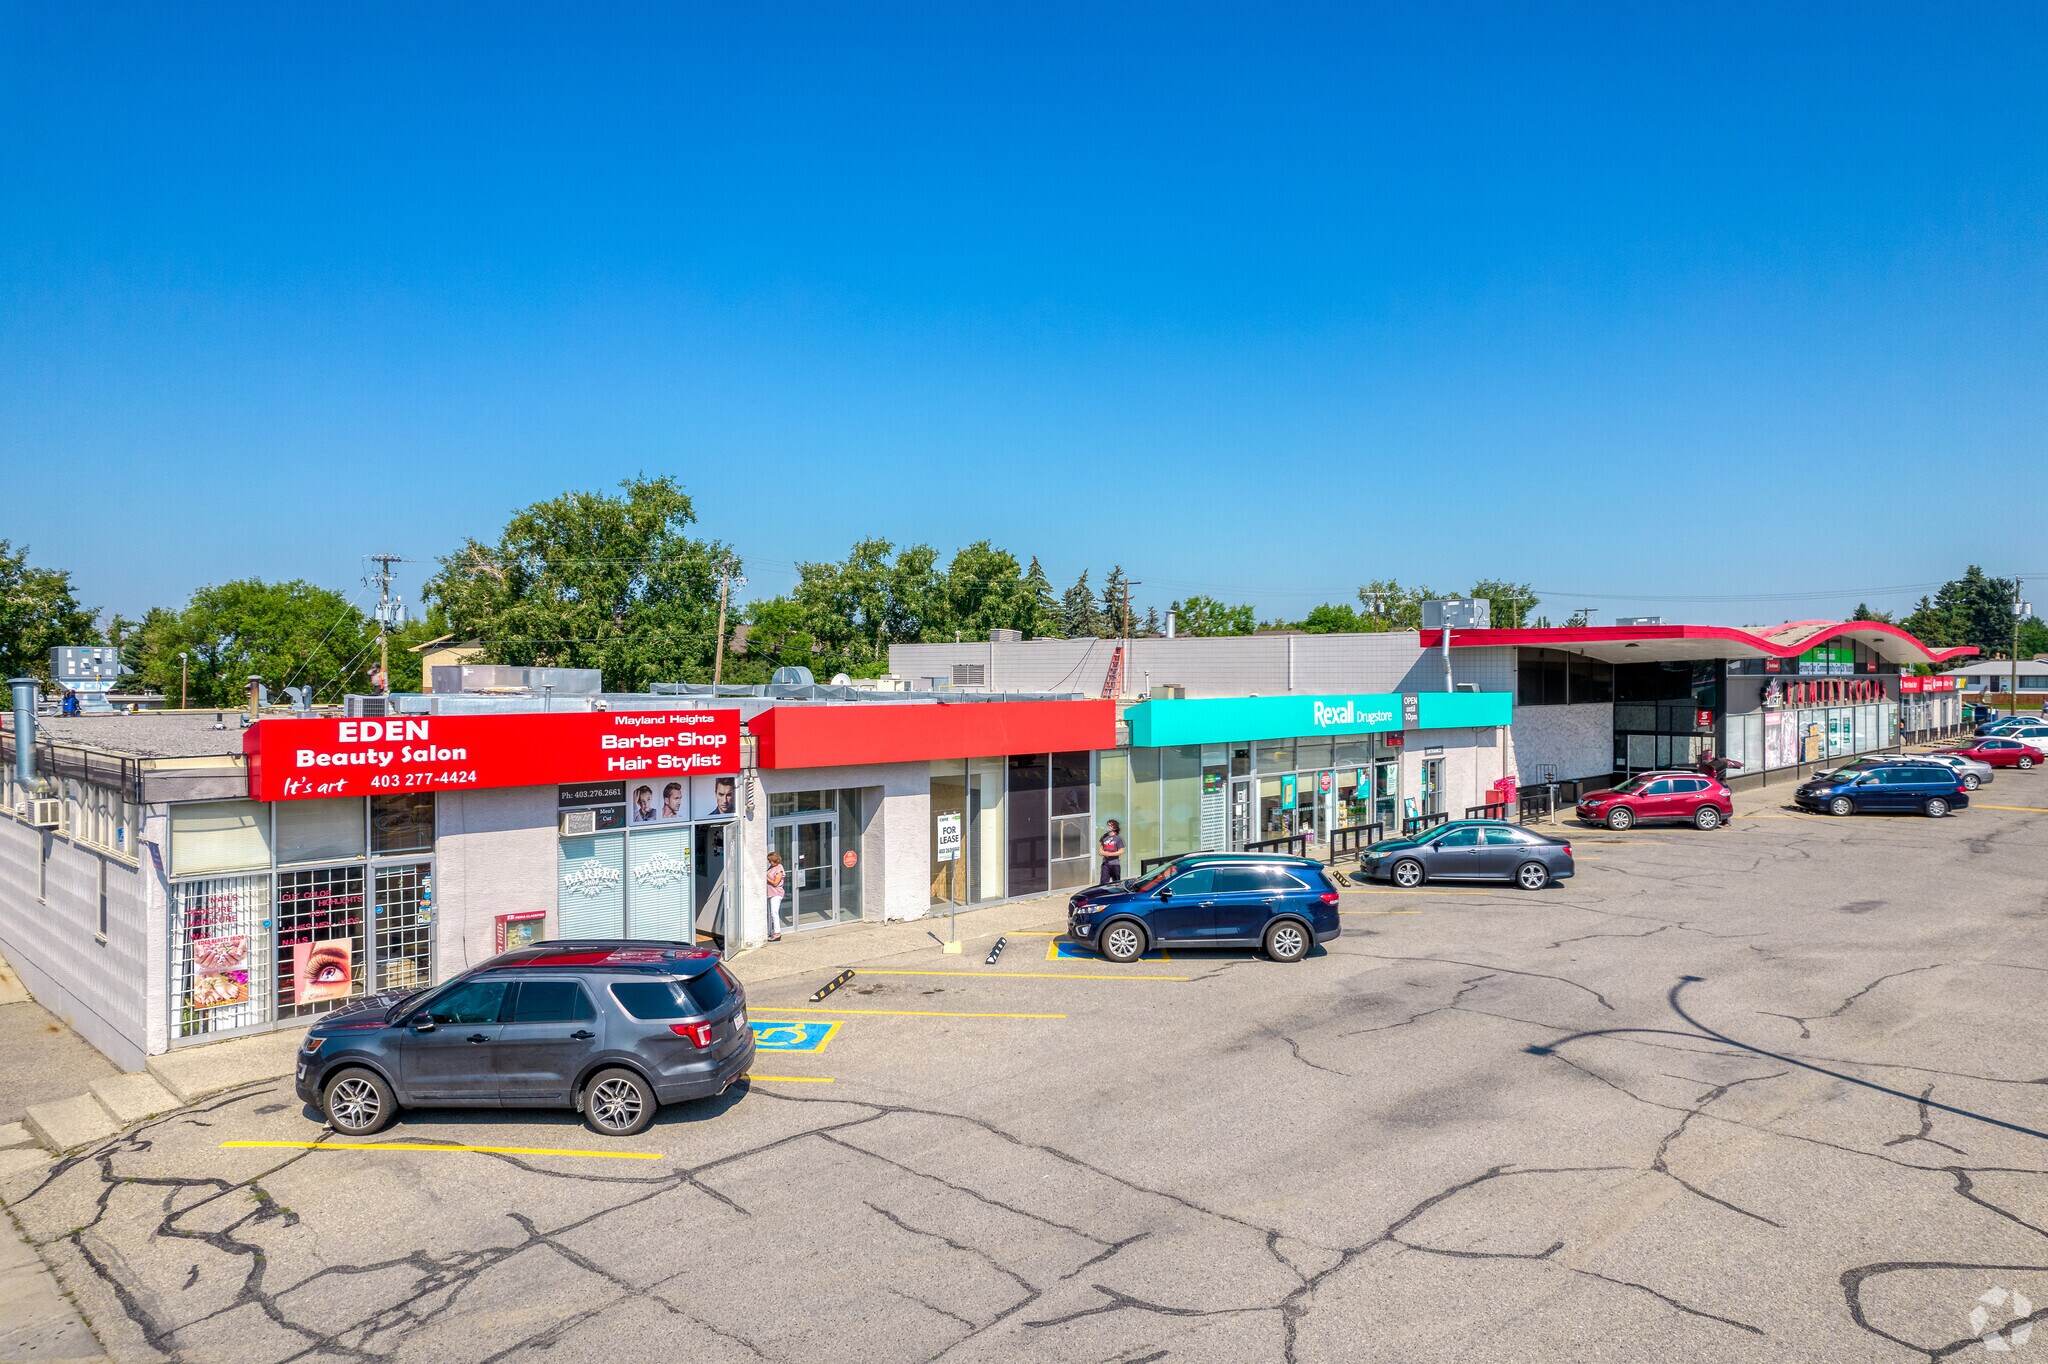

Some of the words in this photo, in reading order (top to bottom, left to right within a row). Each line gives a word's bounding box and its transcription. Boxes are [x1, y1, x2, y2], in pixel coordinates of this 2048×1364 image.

[1785, 680, 1844, 705] FAMILY
[1404, 697, 1417, 705] OPEN
[615, 715, 665, 726] Mayland
[670, 714, 714, 724] Heights
[1314, 700, 1355, 728] Rexall
[1357, 710, 1393, 725] Drugstore
[1405, 713, 1417, 721] 10pm
[338, 720, 429, 743] EDEN
[602, 735, 674, 749] Barber
[678, 732, 727, 748] Shop
[296, 749, 394, 767] Beauty
[401, 745, 467, 763] Salon
[608, 756, 652, 771] Hair
[657, 754, 721, 771] Stylist
[371, 774, 400, 788] 403
[405, 770, 477, 786] 277-4424
[283, 776, 312, 797] It's
[317, 777, 348, 793] art
[575, 788, 621, 799] 403.276.2661
[943, 826, 956, 834] FOR
[940, 835, 959, 844] LEASE
[564, 868, 620, 886] BARBER
[210, 894, 239, 903] NAILS
[282, 893, 300, 901] CUT
[303, 890, 332, 899] COLOR
[318, 896, 363, 907] HIGHLIGHTS
[187, 906, 232, 917] PEDICURE
[187, 915, 238, 927] MANICURE
